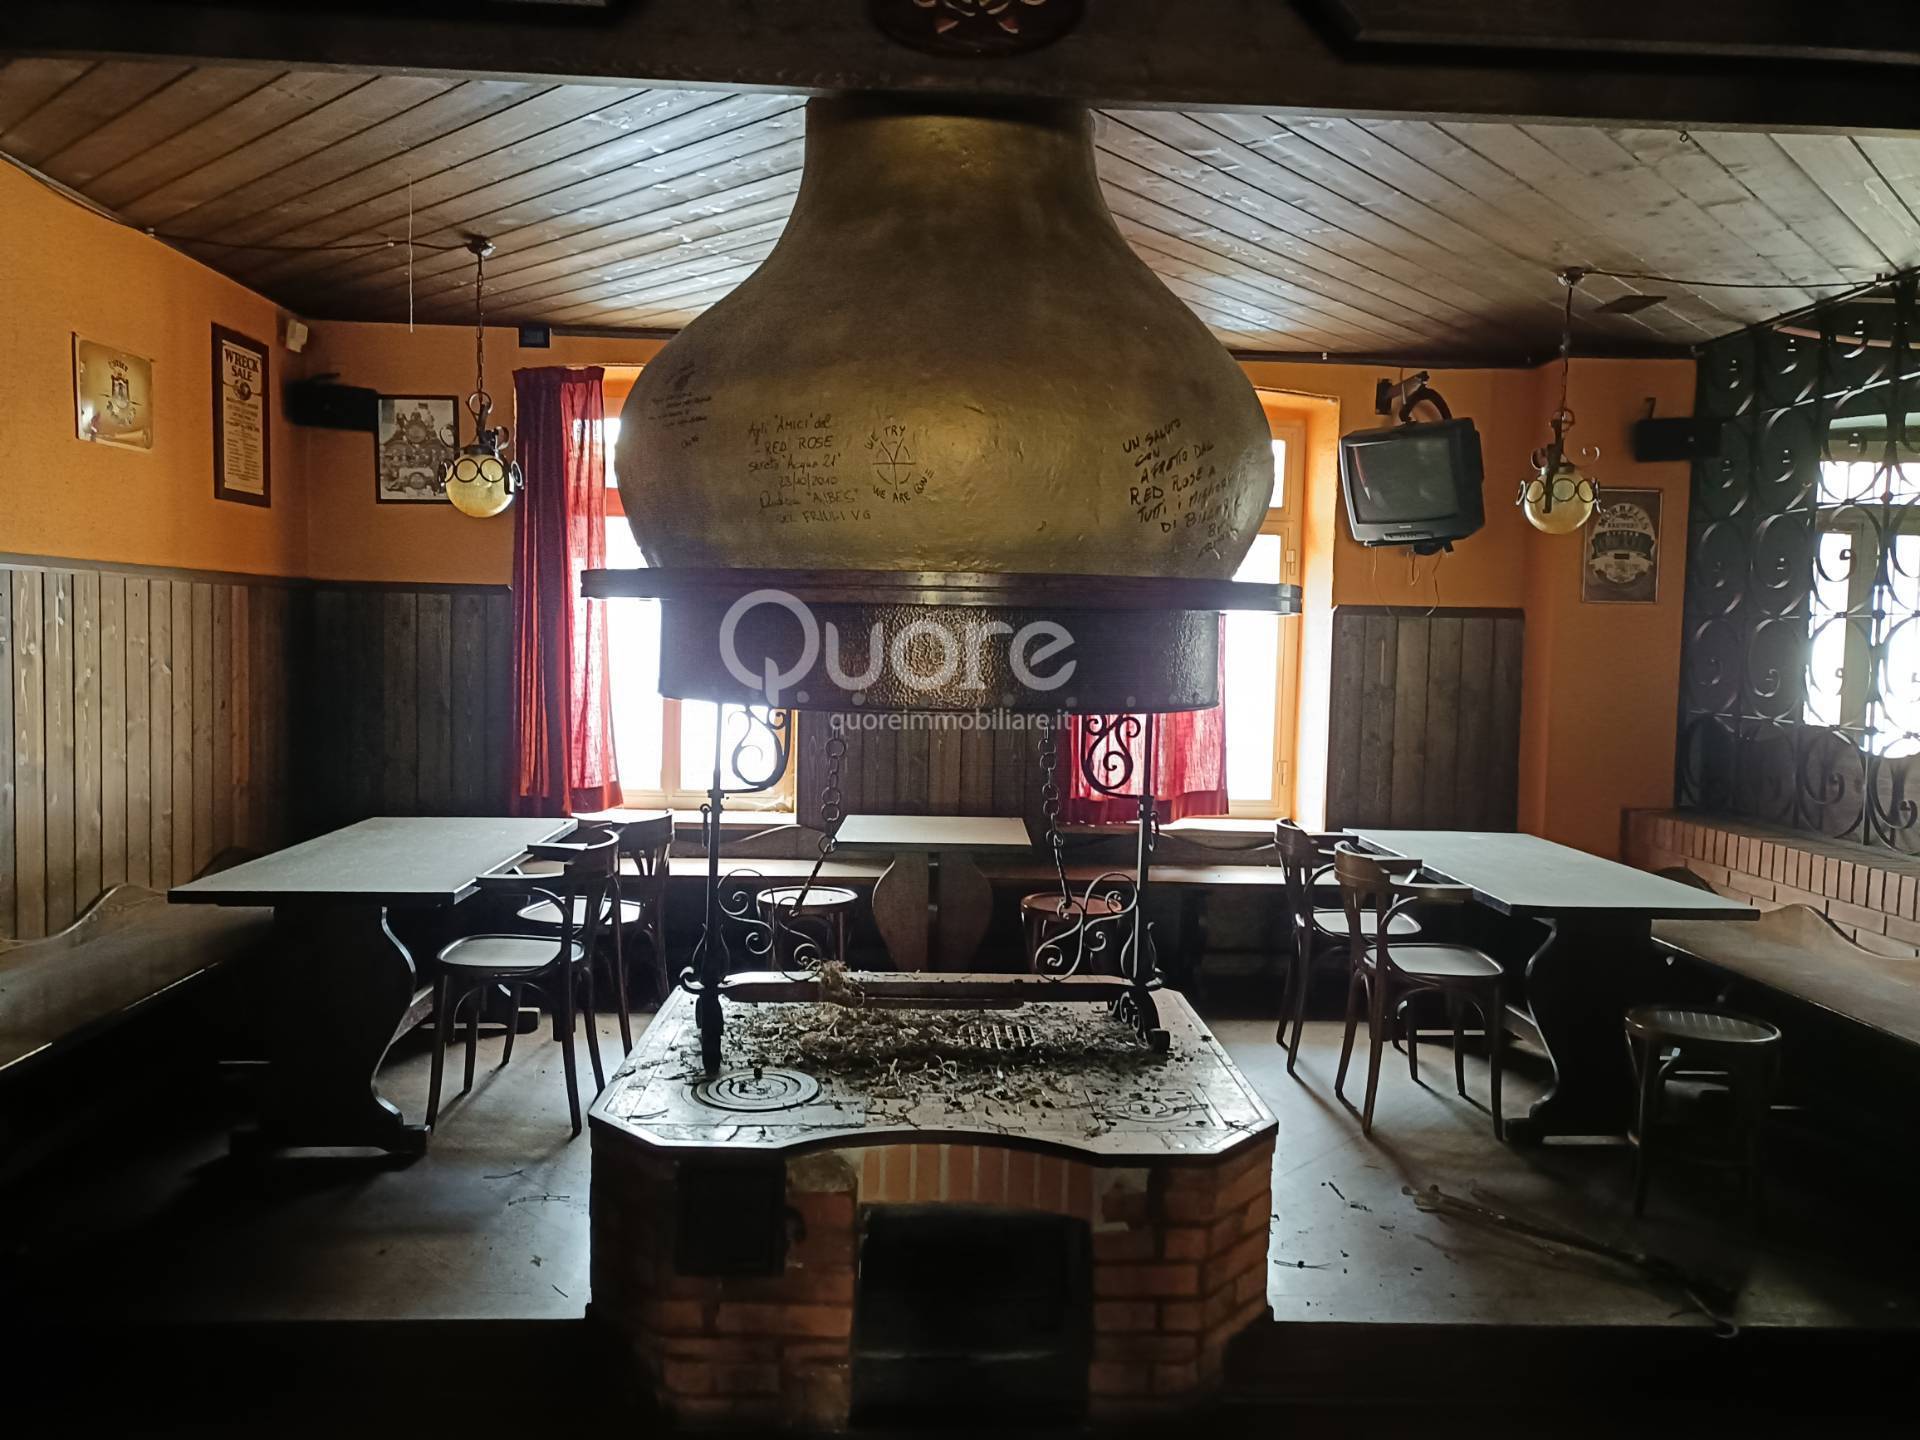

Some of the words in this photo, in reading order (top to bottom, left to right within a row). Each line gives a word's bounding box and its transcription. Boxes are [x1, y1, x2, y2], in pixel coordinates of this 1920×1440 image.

[224, 349, 259, 373] WRECK
[231, 365, 253, 382] SALE
[884, 425, 906, 437] TRY
[1123, 435, 1140, 453] UN
[1145, 418, 1181, 446] SALUTO
[799, 435, 833, 449] ROSE
[893, 491, 912, 504] ARE
[1130, 486, 1164, 506] RED
